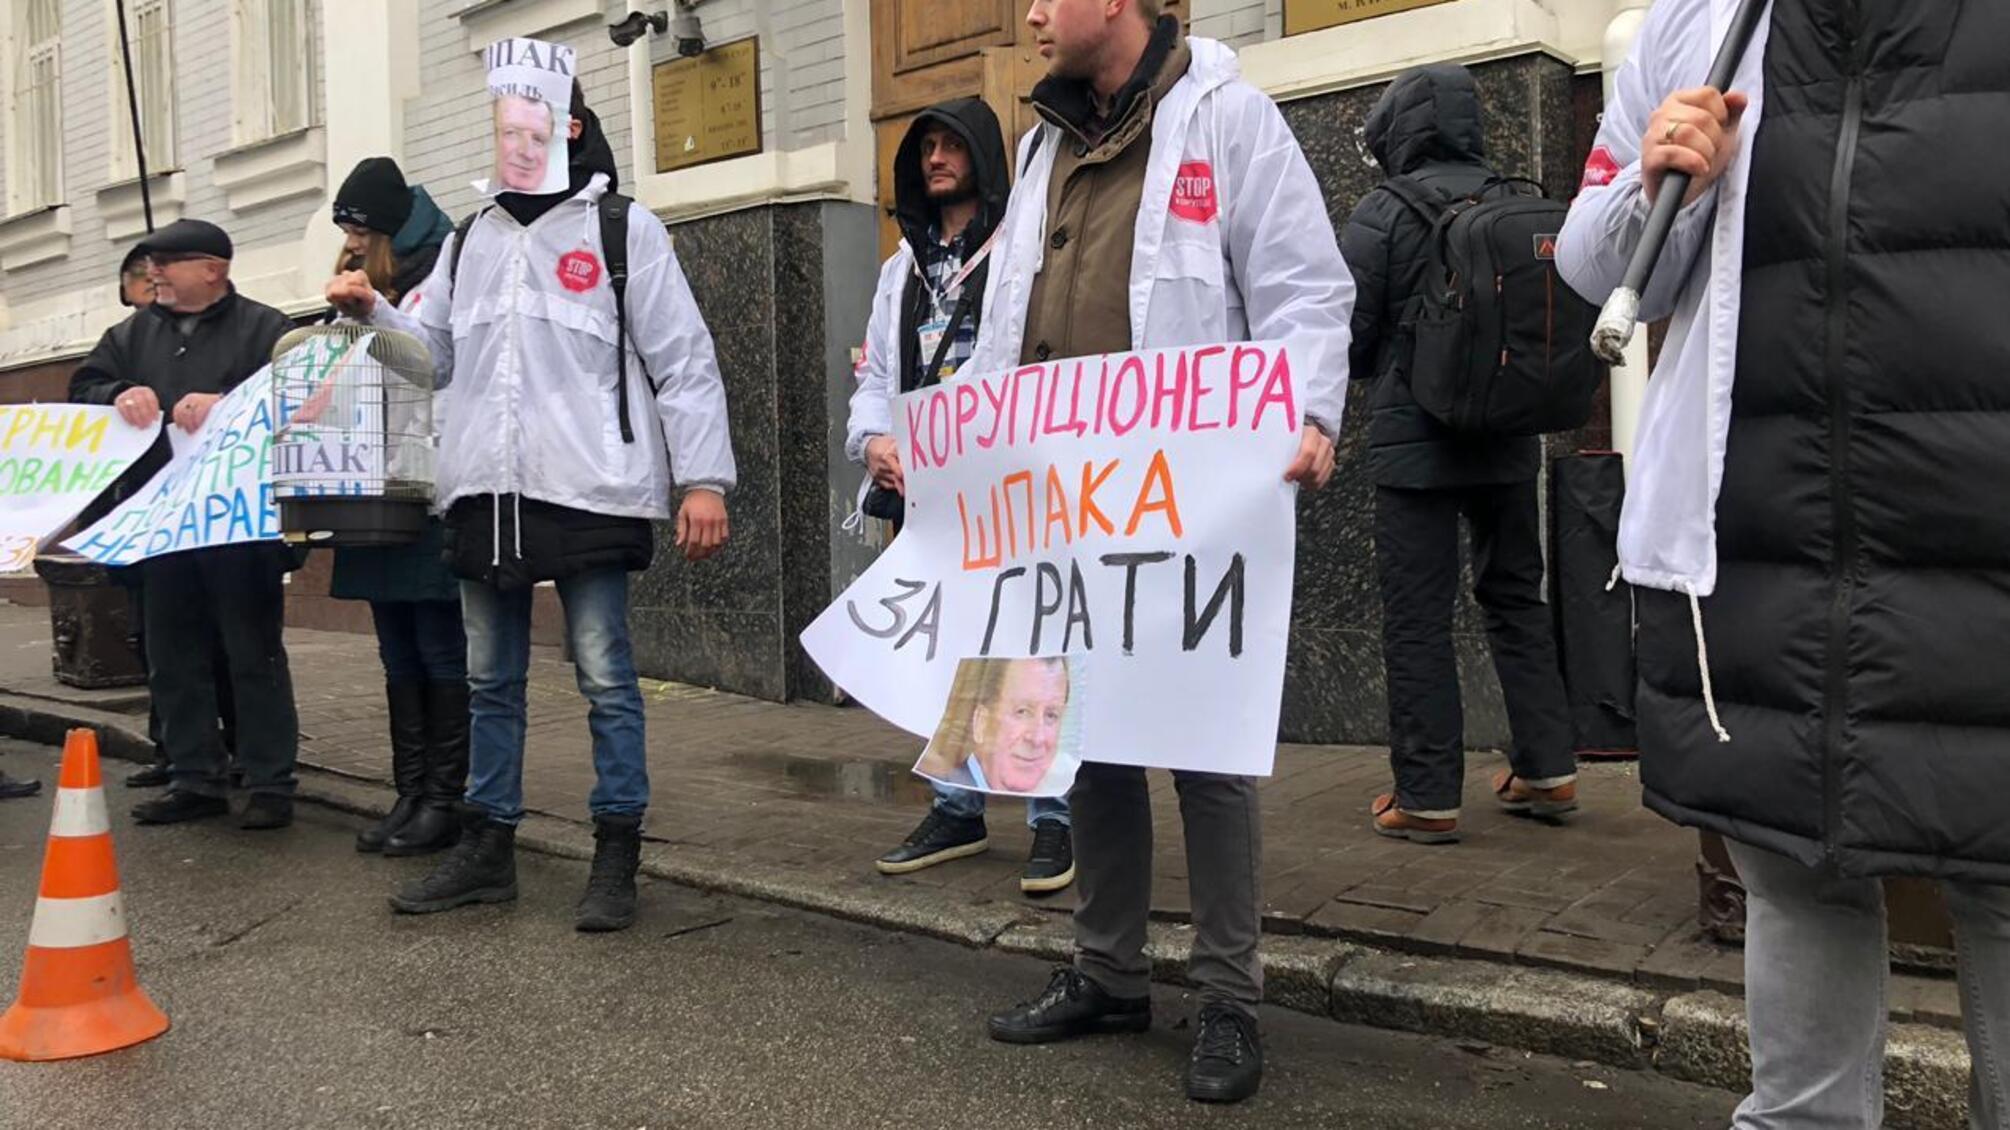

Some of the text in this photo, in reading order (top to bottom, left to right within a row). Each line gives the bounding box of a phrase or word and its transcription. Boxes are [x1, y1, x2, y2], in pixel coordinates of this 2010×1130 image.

[1175, 176, 1211, 197] STOP
[566, 258, 594, 275] STOP
[906, 345, 1297, 472] КОРУПЦІОНЕРА
[956, 449, 1183, 571] ШПАКА
[846, 550, 1246, 662] ЗА ГРАТИ
